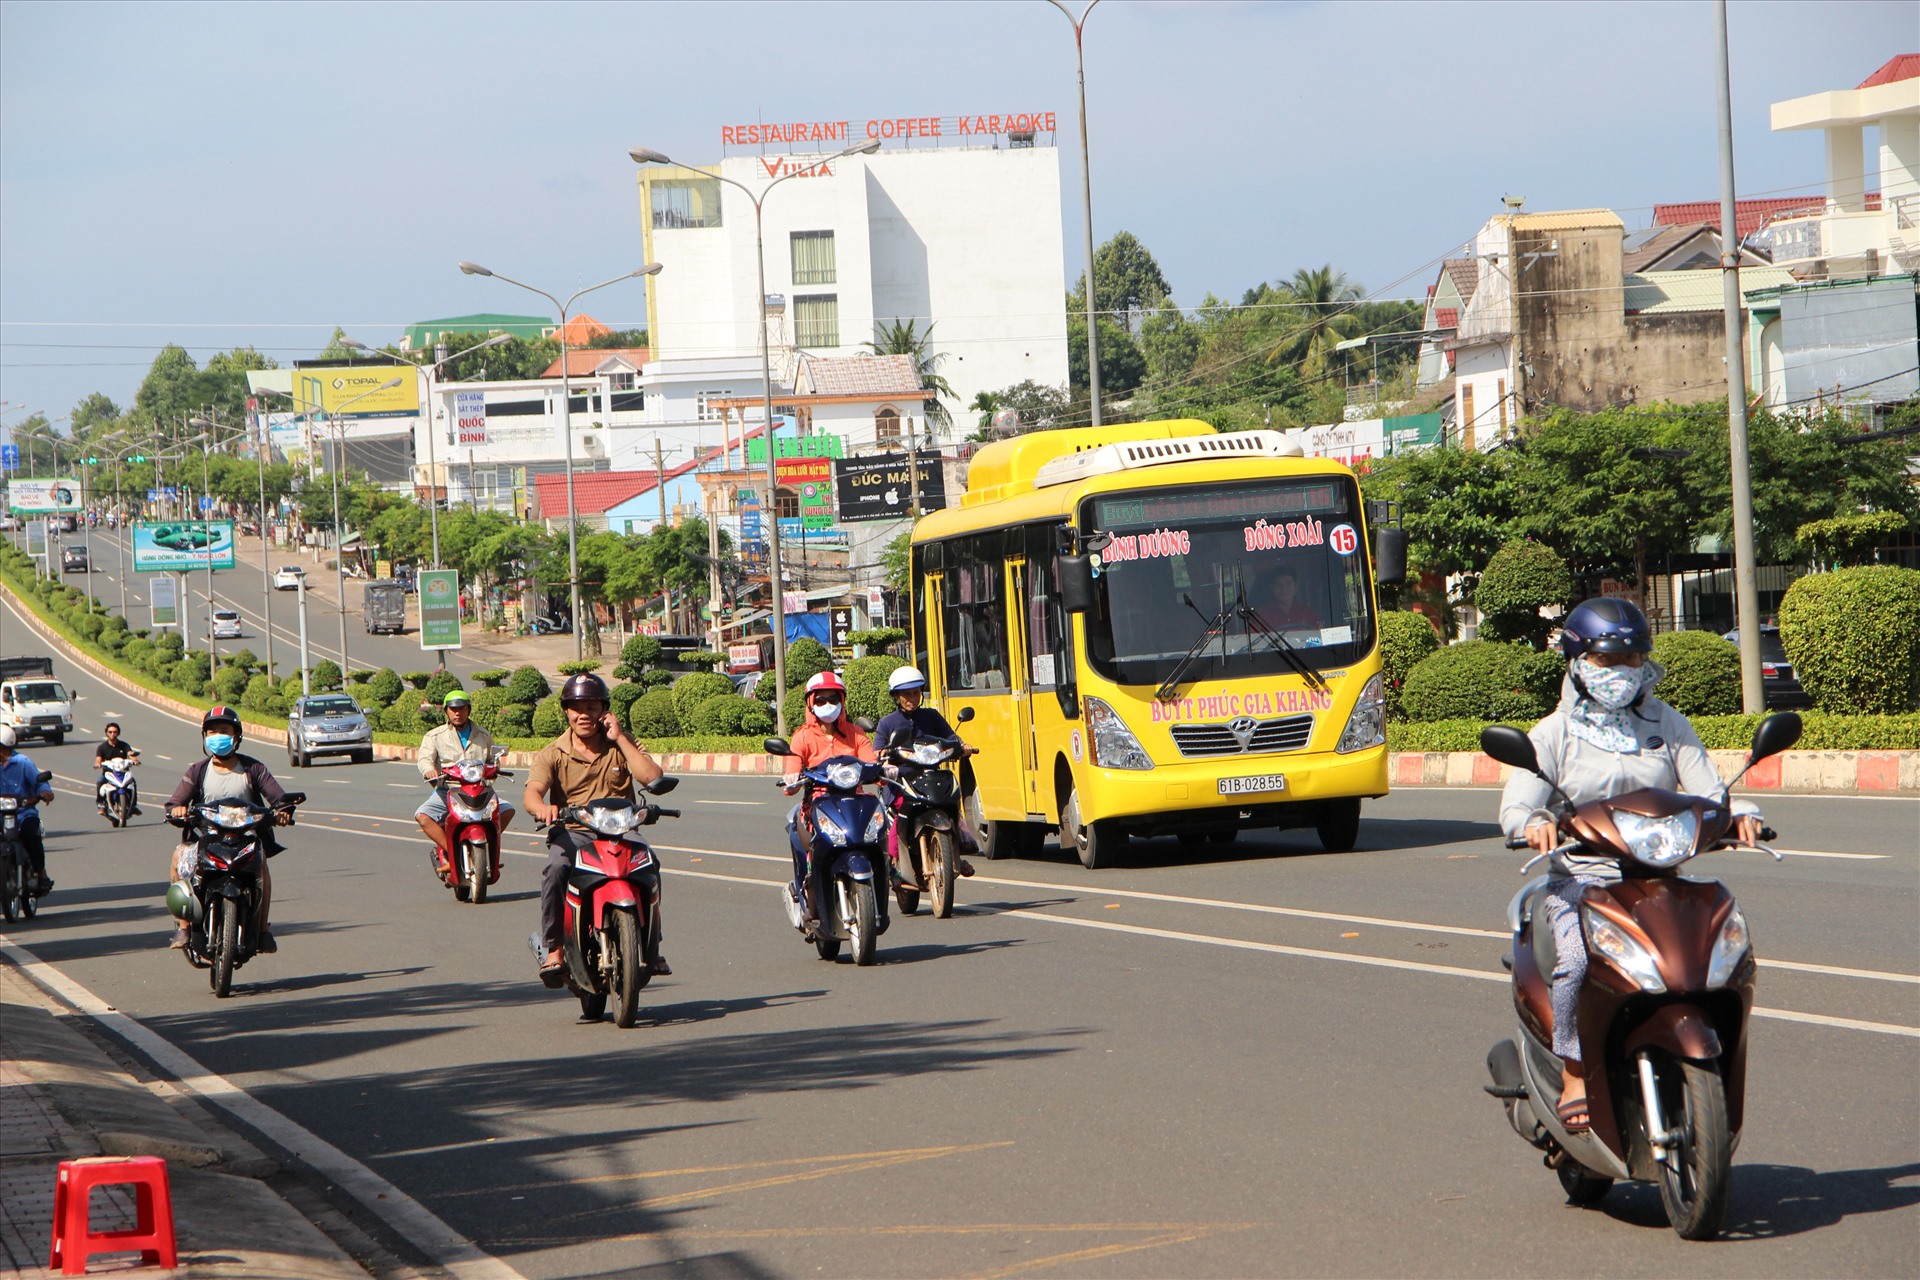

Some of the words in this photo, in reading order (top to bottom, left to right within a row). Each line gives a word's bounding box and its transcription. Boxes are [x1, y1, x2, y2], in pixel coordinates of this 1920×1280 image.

[721, 121, 849, 145] RESTAURANT
[866, 117, 942, 139] COFFEE
[958, 112, 1056, 134] KARAOKE
[345, 377, 381, 385] TOPAL
[457, 393, 468, 401] CỬA
[469, 392, 484, 401] HÀNG
[458, 404, 468, 412] SẮT
[469, 404, 484, 412] THÉP
[458, 414, 485, 429] QUỐC
[460, 430, 485, 442] BÌNH
[801, 427, 844, 460] CỬA
[851, 471, 882, 487] ĐỨC
[1244, 518, 1286, 552] ĐỒNG
[1285, 514, 1324, 547] XOÀI
[1332, 529, 1355, 551] 15
[1102, 531, 1139, 563] BÌNH
[1138, 528, 1191, 559] DƯƠNG
[1197, 688, 1240, 718] PHÚC
[1243, 692, 1273, 715] GIA
[1275, 688, 1332, 713] KHANG
[1219, 774, 1283, 793] 61B-028.55
